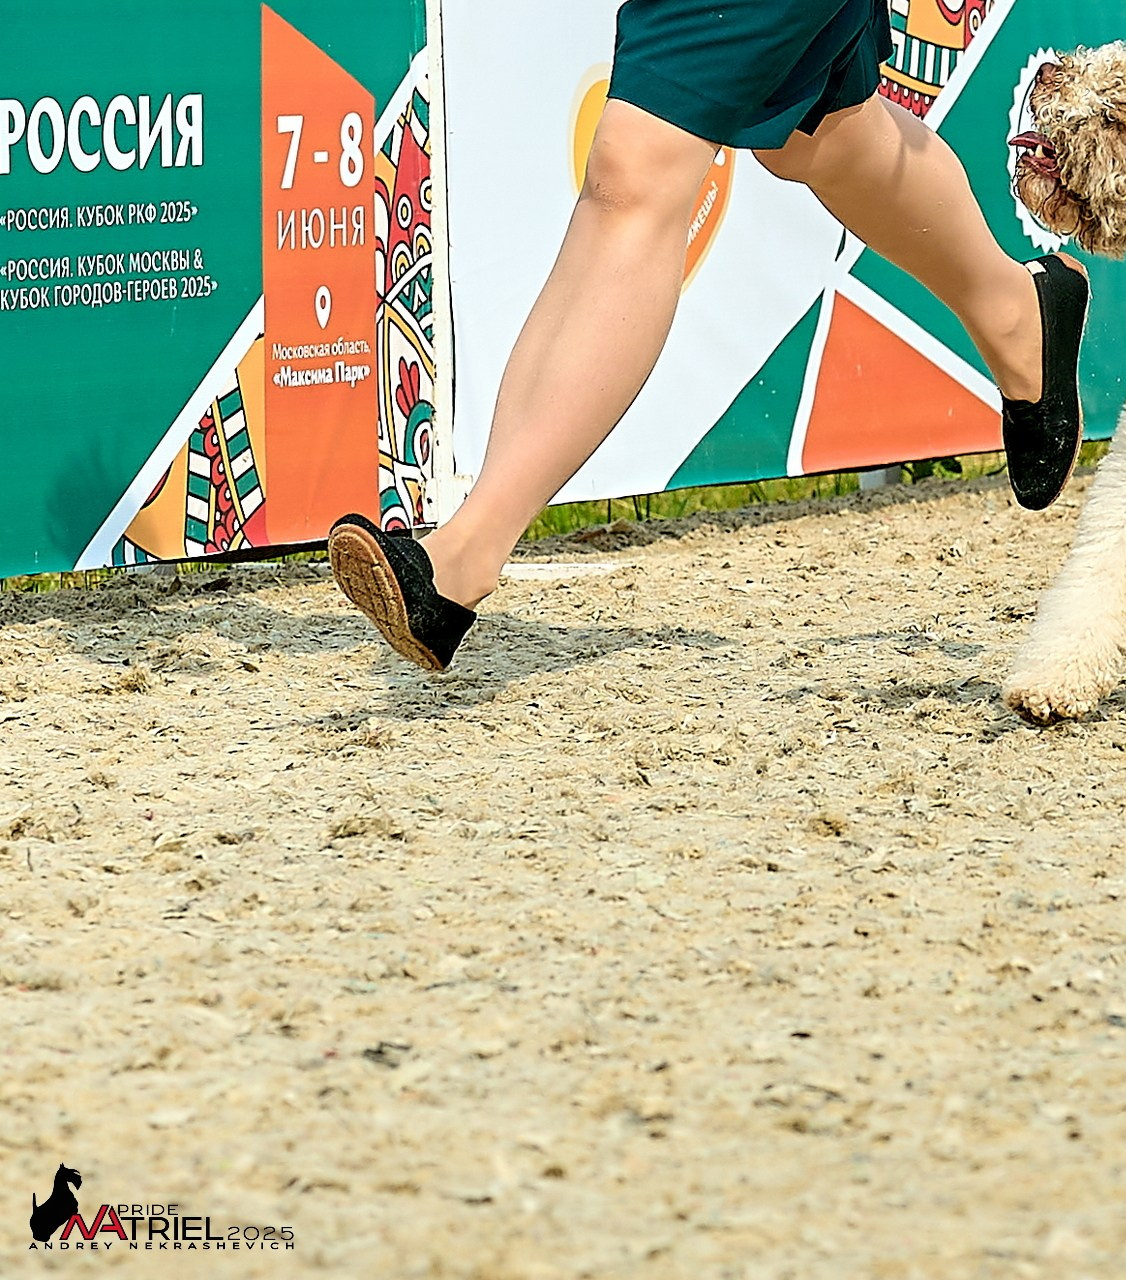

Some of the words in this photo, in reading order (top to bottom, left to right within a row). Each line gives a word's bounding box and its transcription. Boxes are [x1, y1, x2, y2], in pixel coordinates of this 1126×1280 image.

[0, 93, 203, 175] РОССИЯ
[0, 207, 73, 232] «РОССИЯ.
[77, 203, 125, 227] КУБОК
[128, 202, 157, 225] РКФ
[160, 201, 199, 223] 2025»
[277, 206, 364, 250] ИЮНЯ
[0, 256, 74, 282] «РОССИЯ.
[77, 253, 125, 277] КУБОК
[129, 249, 190, 274] МОСКВЫ
[193, 248, 204, 270] &
[0, 286, 50, 311] КУБОК
[54, 277, 178, 308] ГОРОДОВ-ГЕРОЕВ
[180, 275, 218, 298] 2025»
[272, 343, 330, 360] Московская
[273, 365, 333, 388] «Максима
[334, 360, 371, 388] Парк»
